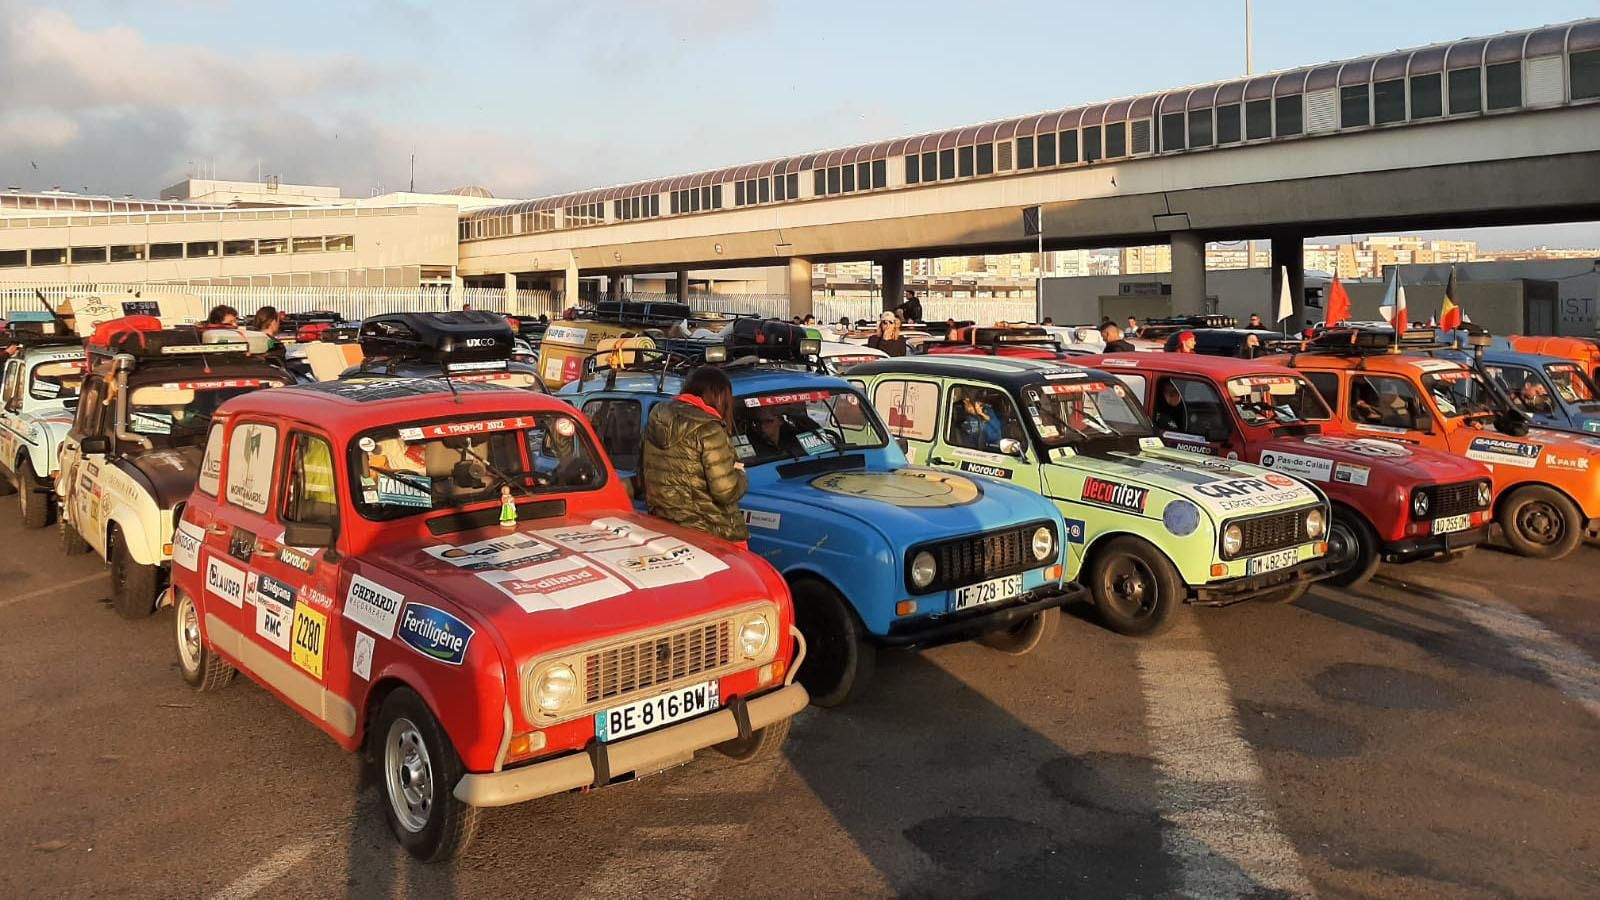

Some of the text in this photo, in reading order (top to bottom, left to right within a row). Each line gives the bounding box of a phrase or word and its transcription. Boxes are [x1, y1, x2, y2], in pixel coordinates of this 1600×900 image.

[433, 427, 446, 435] 4L
[448, 423, 484, 434] TROPHY
[486, 421, 505, 431] 2022
[1475, 438, 1521, 449] GARAGE
[967, 462, 1005, 477] Norauto
[1193, 478, 1280, 499] CAFPI
[280, 549, 310, 571] Norauto
[352, 583, 398, 614] GHERARDI
[264, 614, 282, 638] RMC
[295, 612, 321, 656] 2280
[610, 686, 706, 735] BE-816-BW
